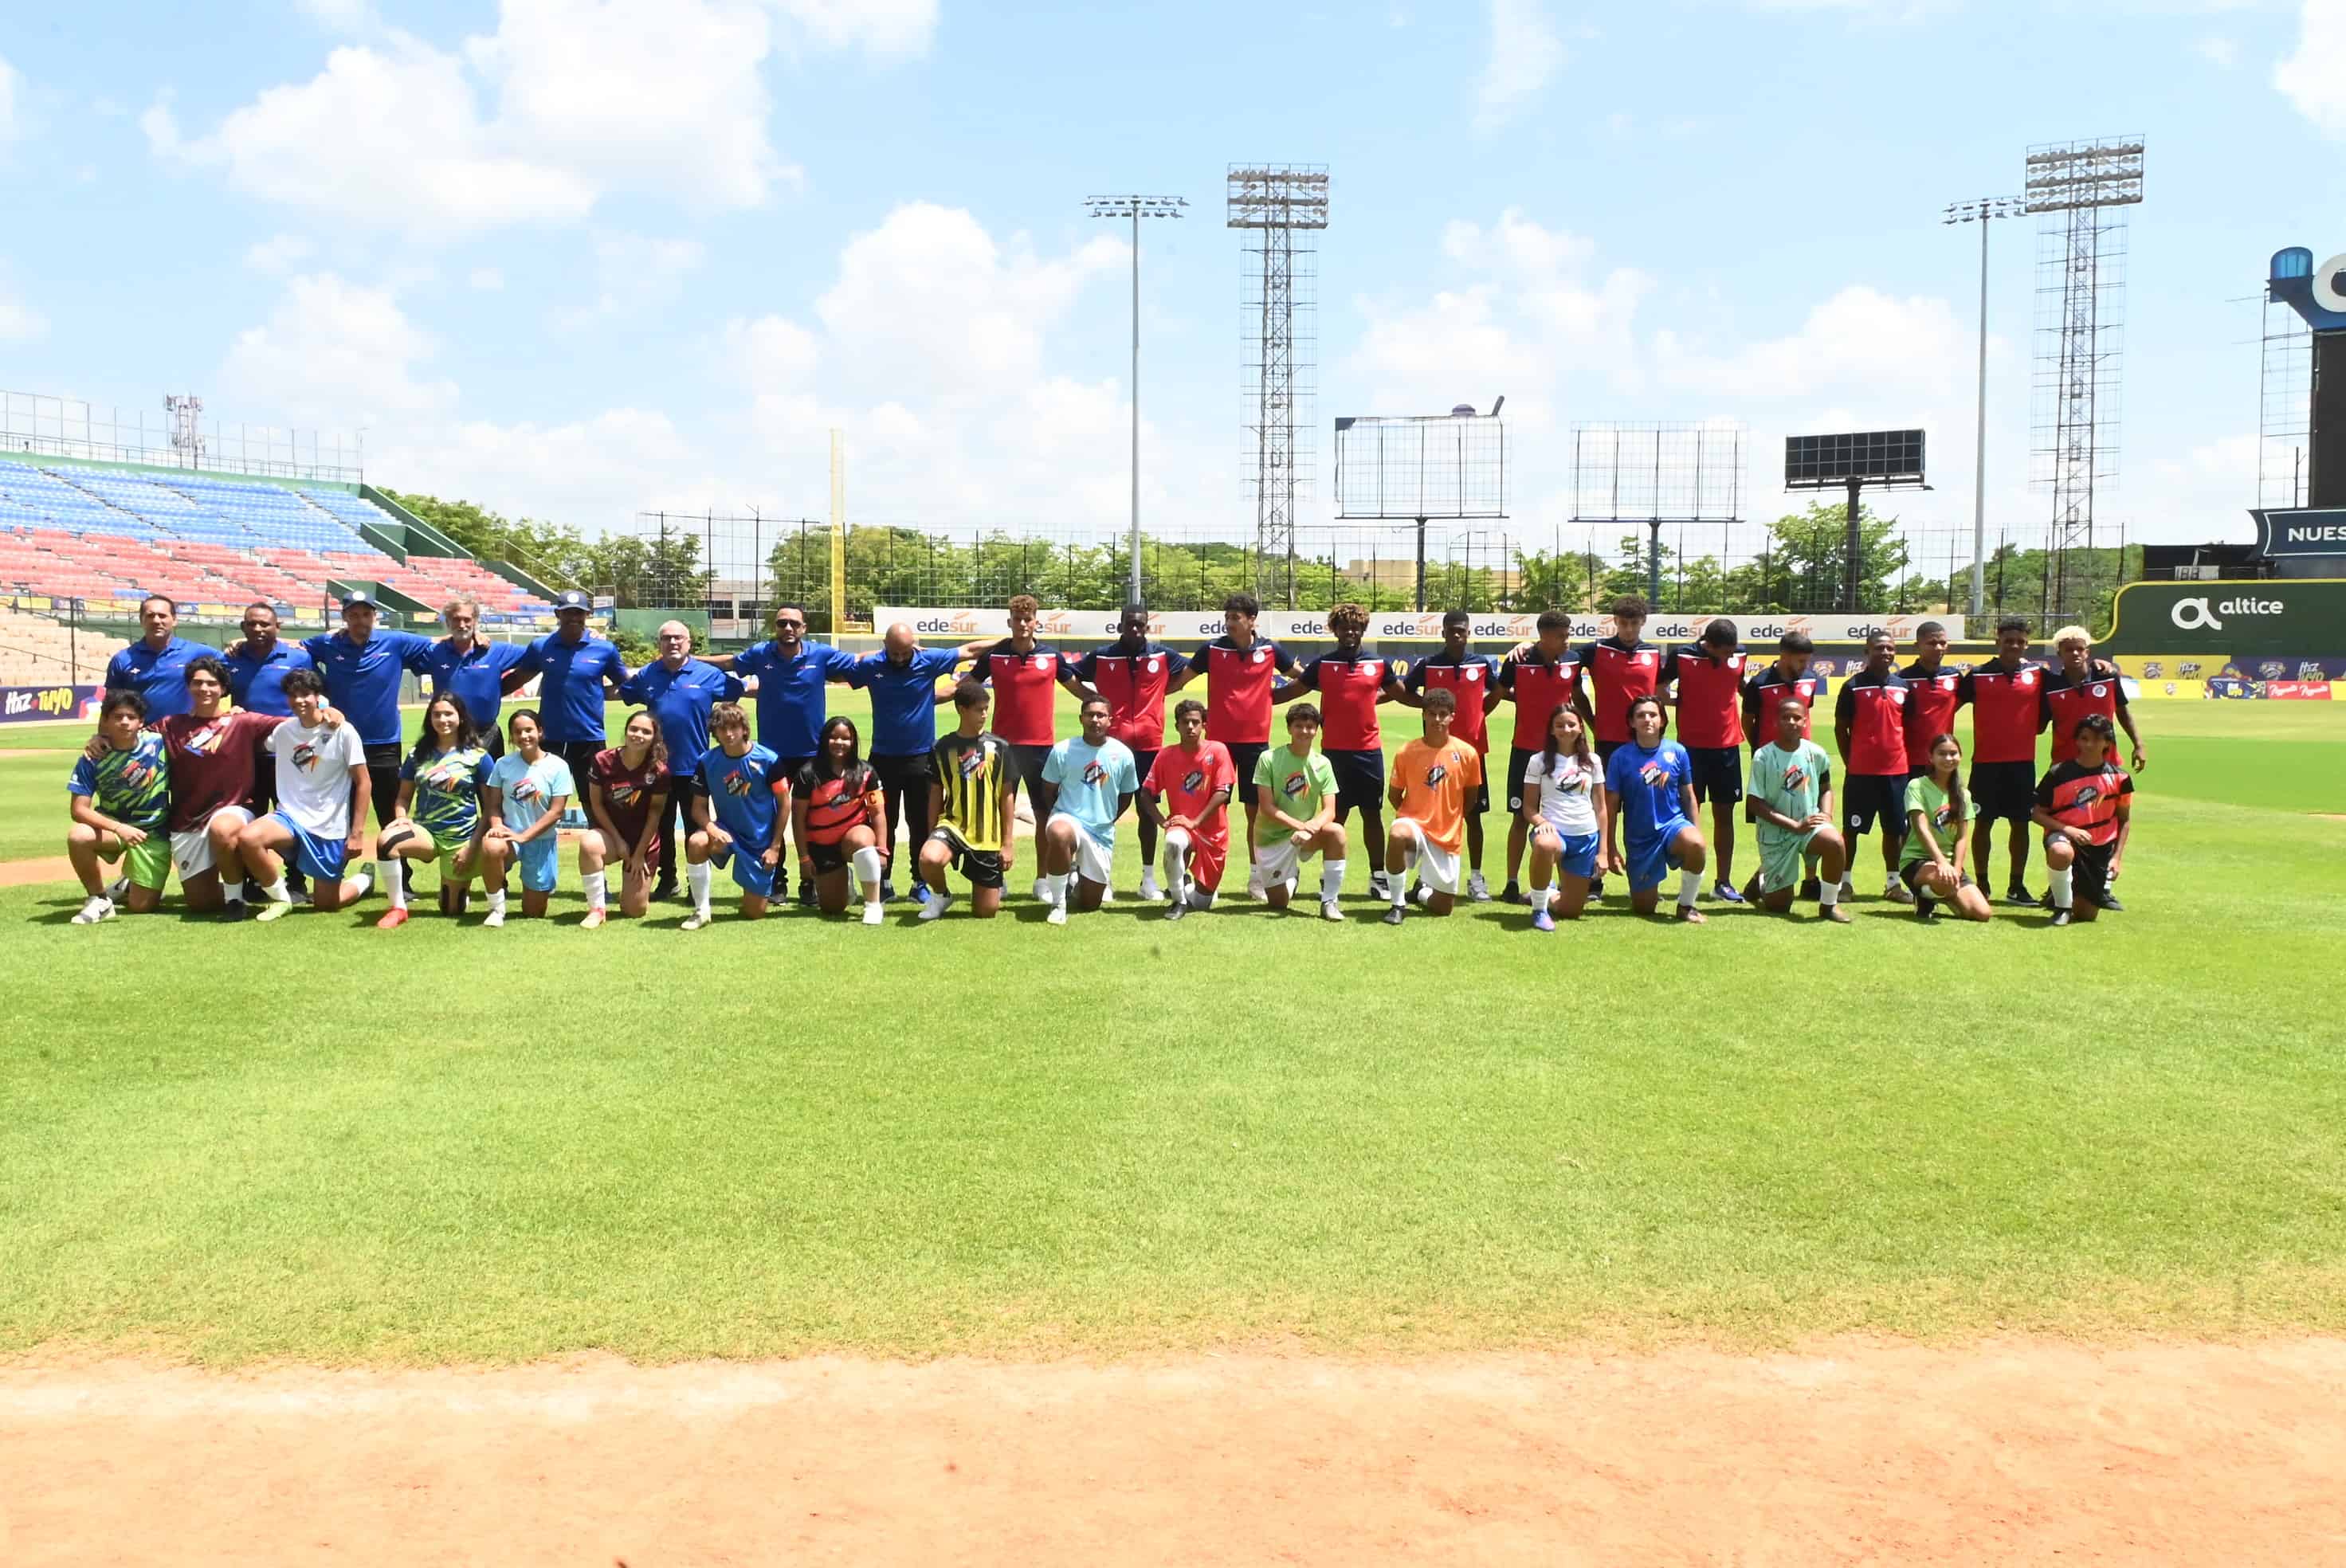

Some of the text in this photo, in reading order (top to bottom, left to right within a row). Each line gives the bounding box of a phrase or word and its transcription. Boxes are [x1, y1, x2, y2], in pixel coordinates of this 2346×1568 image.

[2288, 526, 2346, 542] NUES
[2218, 597, 2283, 614] altice
[916, 618, 978, 633] edesur
[1034, 623, 1071, 634] esur
[1383, 621, 1442, 635] edesur
[1474, 622, 1533, 637] edesur
[1568, 623, 1616, 637] edesu
[1656, 623, 1701, 637] edes
[38, 687, 73, 715] TUYO
